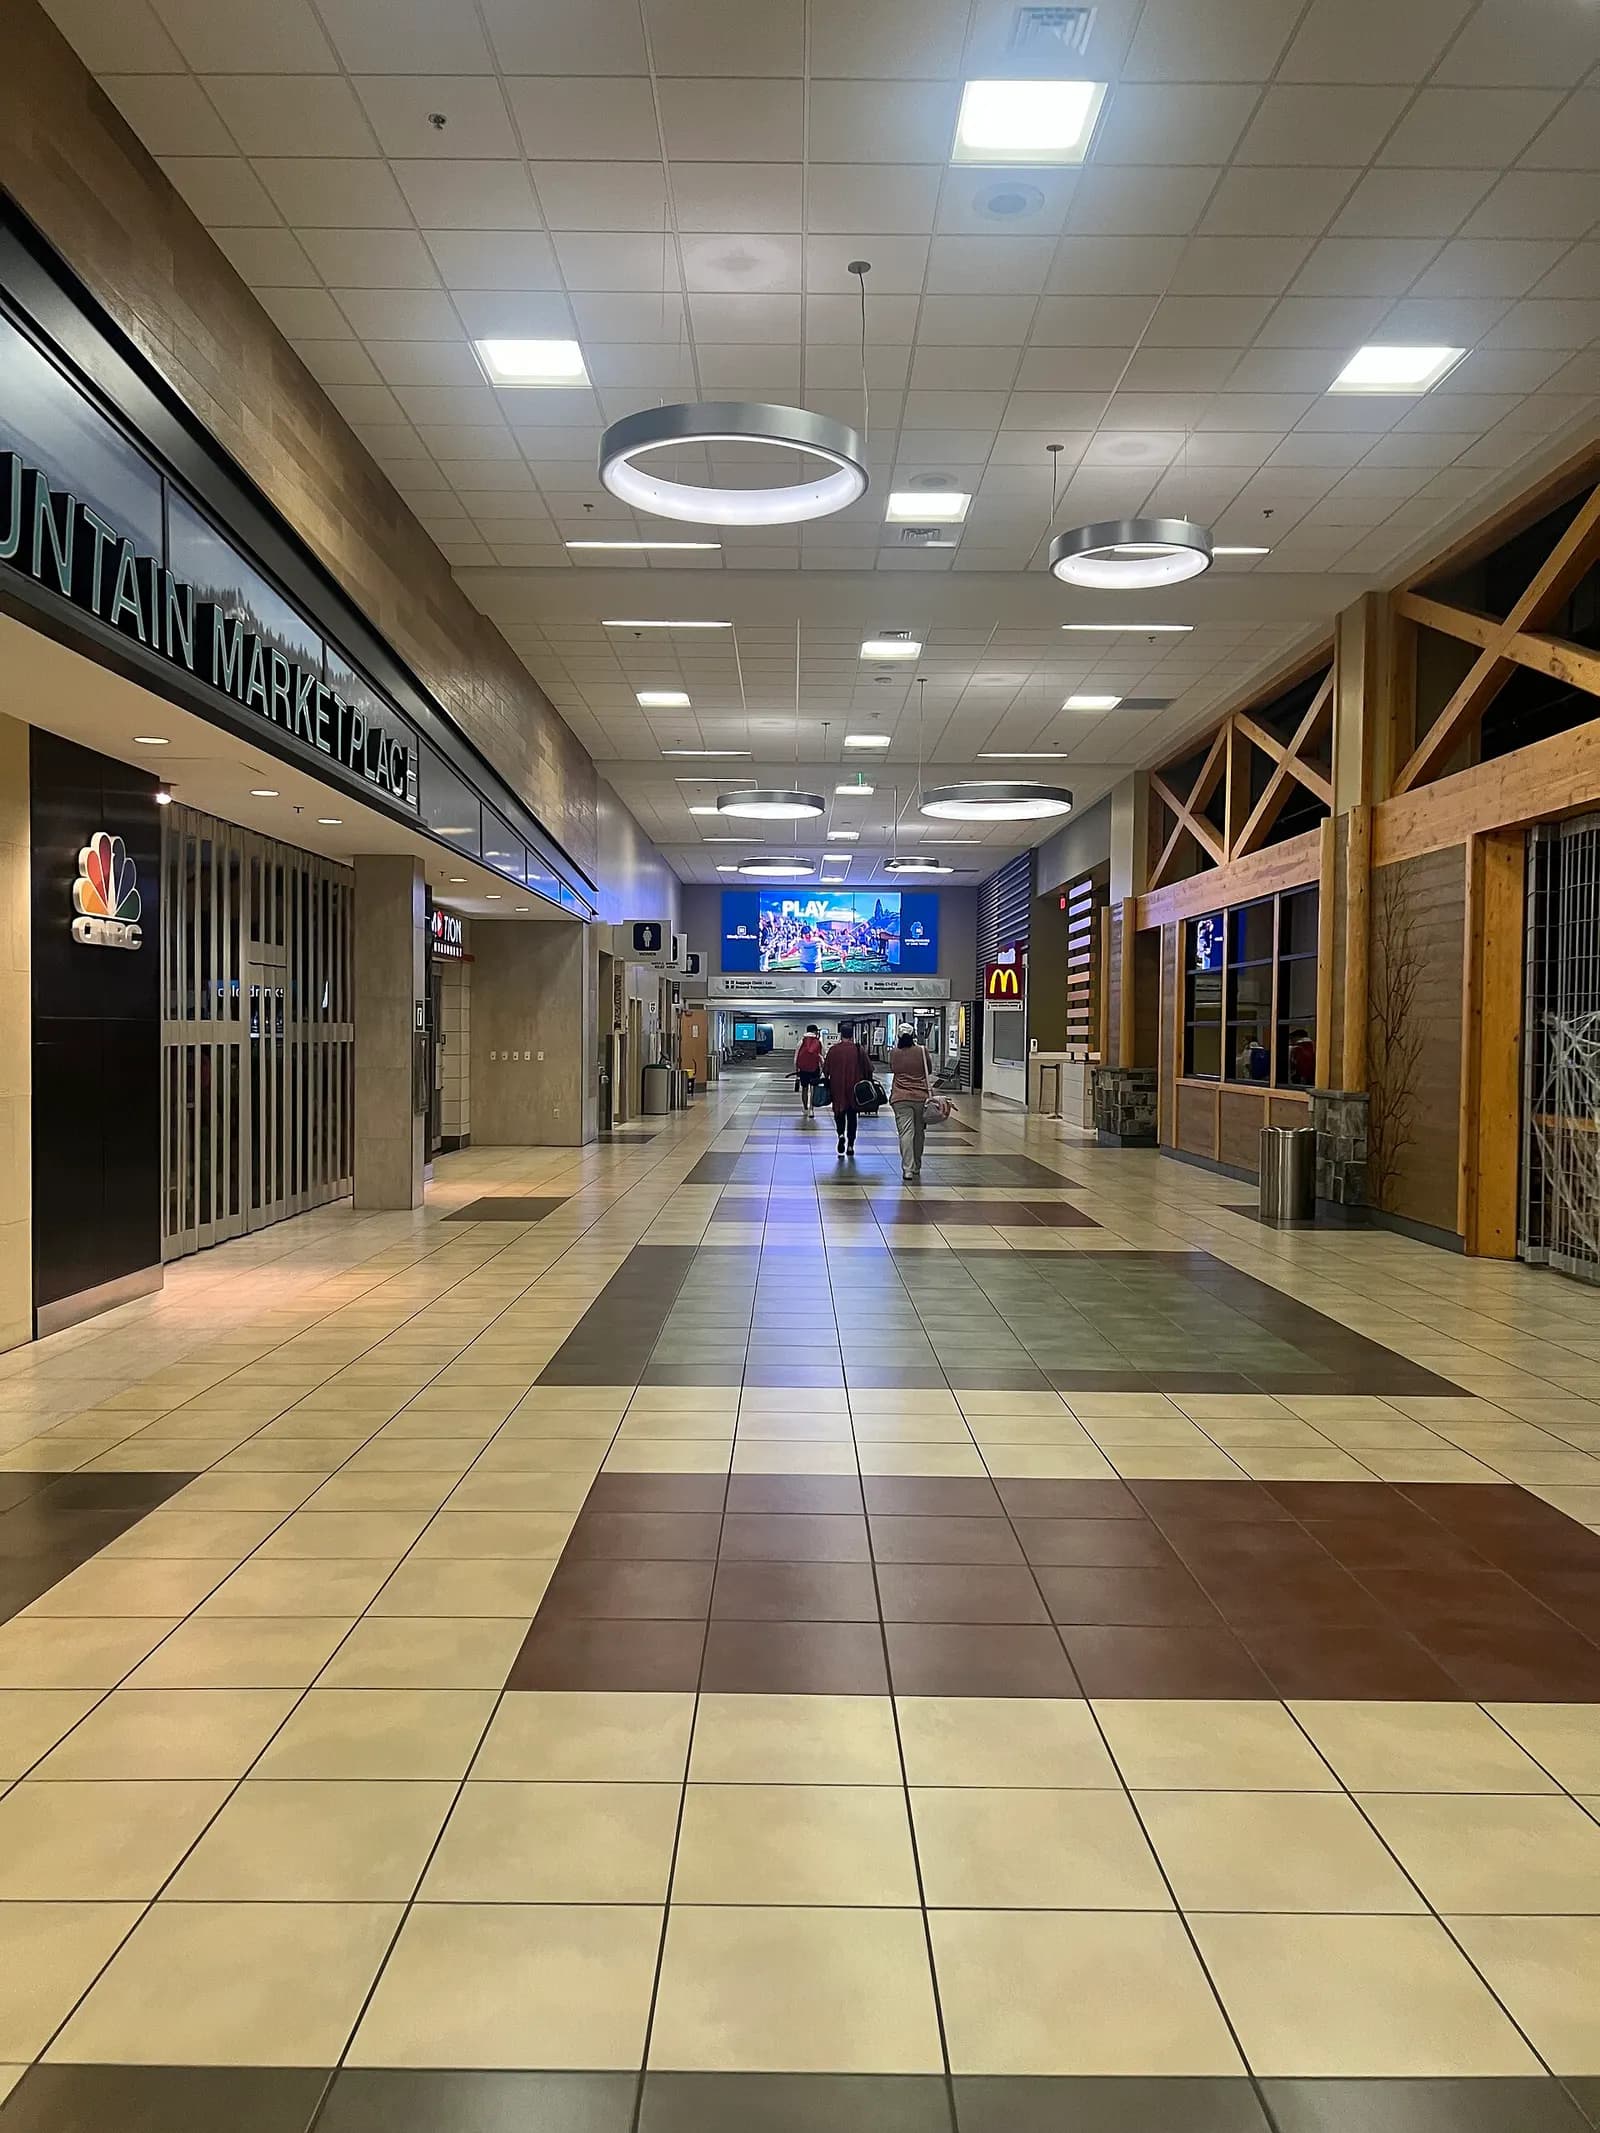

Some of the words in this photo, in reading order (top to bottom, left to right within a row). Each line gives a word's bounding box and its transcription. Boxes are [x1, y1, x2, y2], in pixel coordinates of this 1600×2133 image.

[210, 603, 418, 806] MARKETPLACE
[781, 900, 829, 917] PLAY
[72, 916, 143, 950] CNBC
